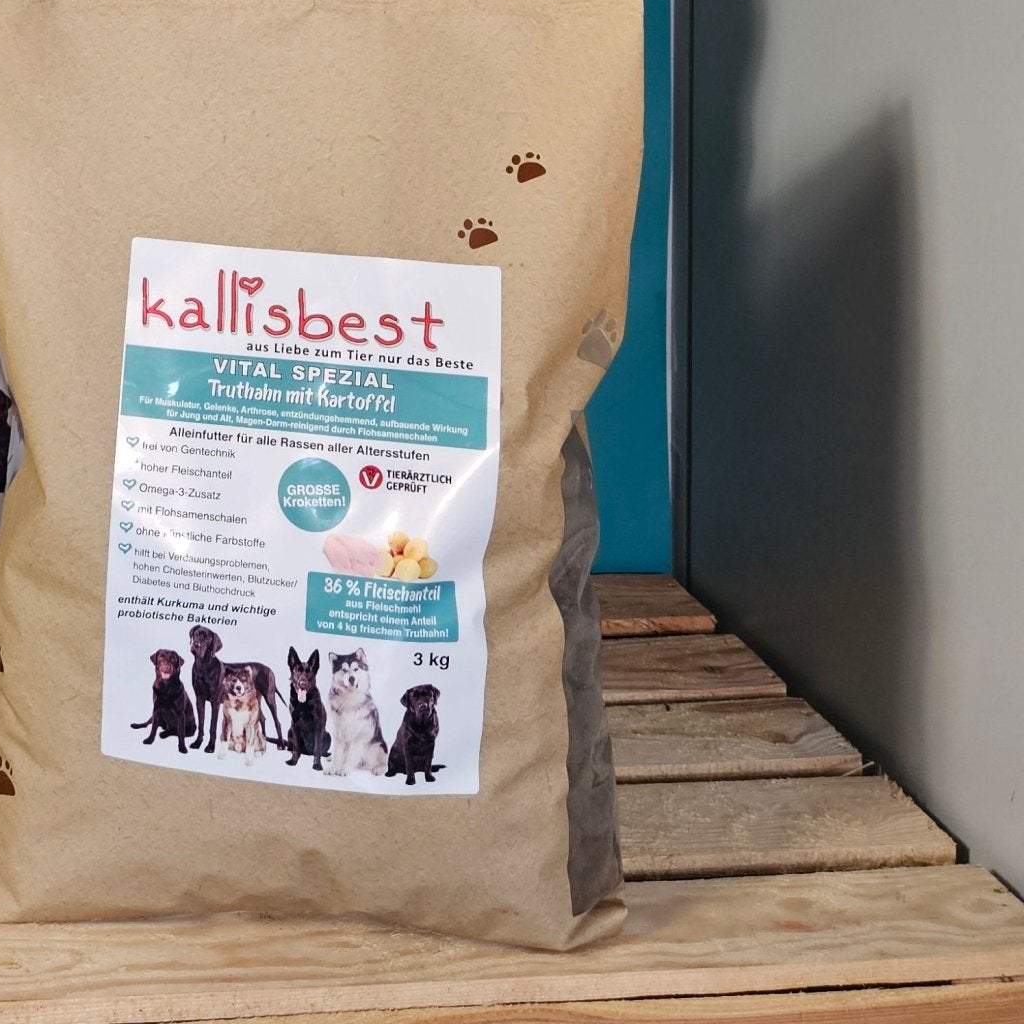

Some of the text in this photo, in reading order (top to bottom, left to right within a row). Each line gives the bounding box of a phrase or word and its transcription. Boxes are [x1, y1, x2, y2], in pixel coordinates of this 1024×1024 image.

[141, 268, 445, 350] kallisbest
[246, 342, 474, 371] aus Liebe zum Tier nur das Beste
[213, 358, 394, 390] VITAL SPEZIAL
[208, 379, 396, 414] Truthahn mit Kartoffel
[139, 396, 468, 436] Für Muskulatur, Gelenke, Arthrose, entzündungshemmend, aufbauende Wirkung
[166, 408, 437, 442] für Jung und Alt, Magen-Darm-reinigend durch Flohsamenschalen
[142, 442, 236, 458] frei von Gentechnik
[169, 427, 430, 461] Alleinfutter für alle Rassen aller Altersstufen
[140, 462, 232, 480] hoher Fleischanteil
[386, 469, 452, 484] TIERÄRZTLICH
[139, 482, 222, 500] Omega-3-Zusatz
[287, 484, 340, 496] GROSSE
[386, 481, 427, 493] GEPRÜFT
[283, 495, 346, 508] Kroketten!
[137, 505, 247, 524] mit Flohsamenschalen
[136, 526, 160, 537] ohne
[215, 534, 266, 548] Farbstoffe
[134, 548, 270, 572] hilft bei Verdauungsproblemen,
[133, 562, 298, 588] hohen Cholesterinwerten, Blutzucker/
[132, 575, 256, 597] Diabetes und Bluthochdruck
[324, 577, 441, 602] 36 % Fleischanteil
[118, 595, 277, 617] enthält Kurkuma und wichtige
[345, 600, 421, 614] aus Fleischmehl
[117, 608, 238, 626] probiotische Bakterien
[329, 609, 437, 626] entspricht einem Anteil
[317, 620, 449, 638] von 4 kg frischem Truthahn!
[413, 652, 450, 670] 3 kg
